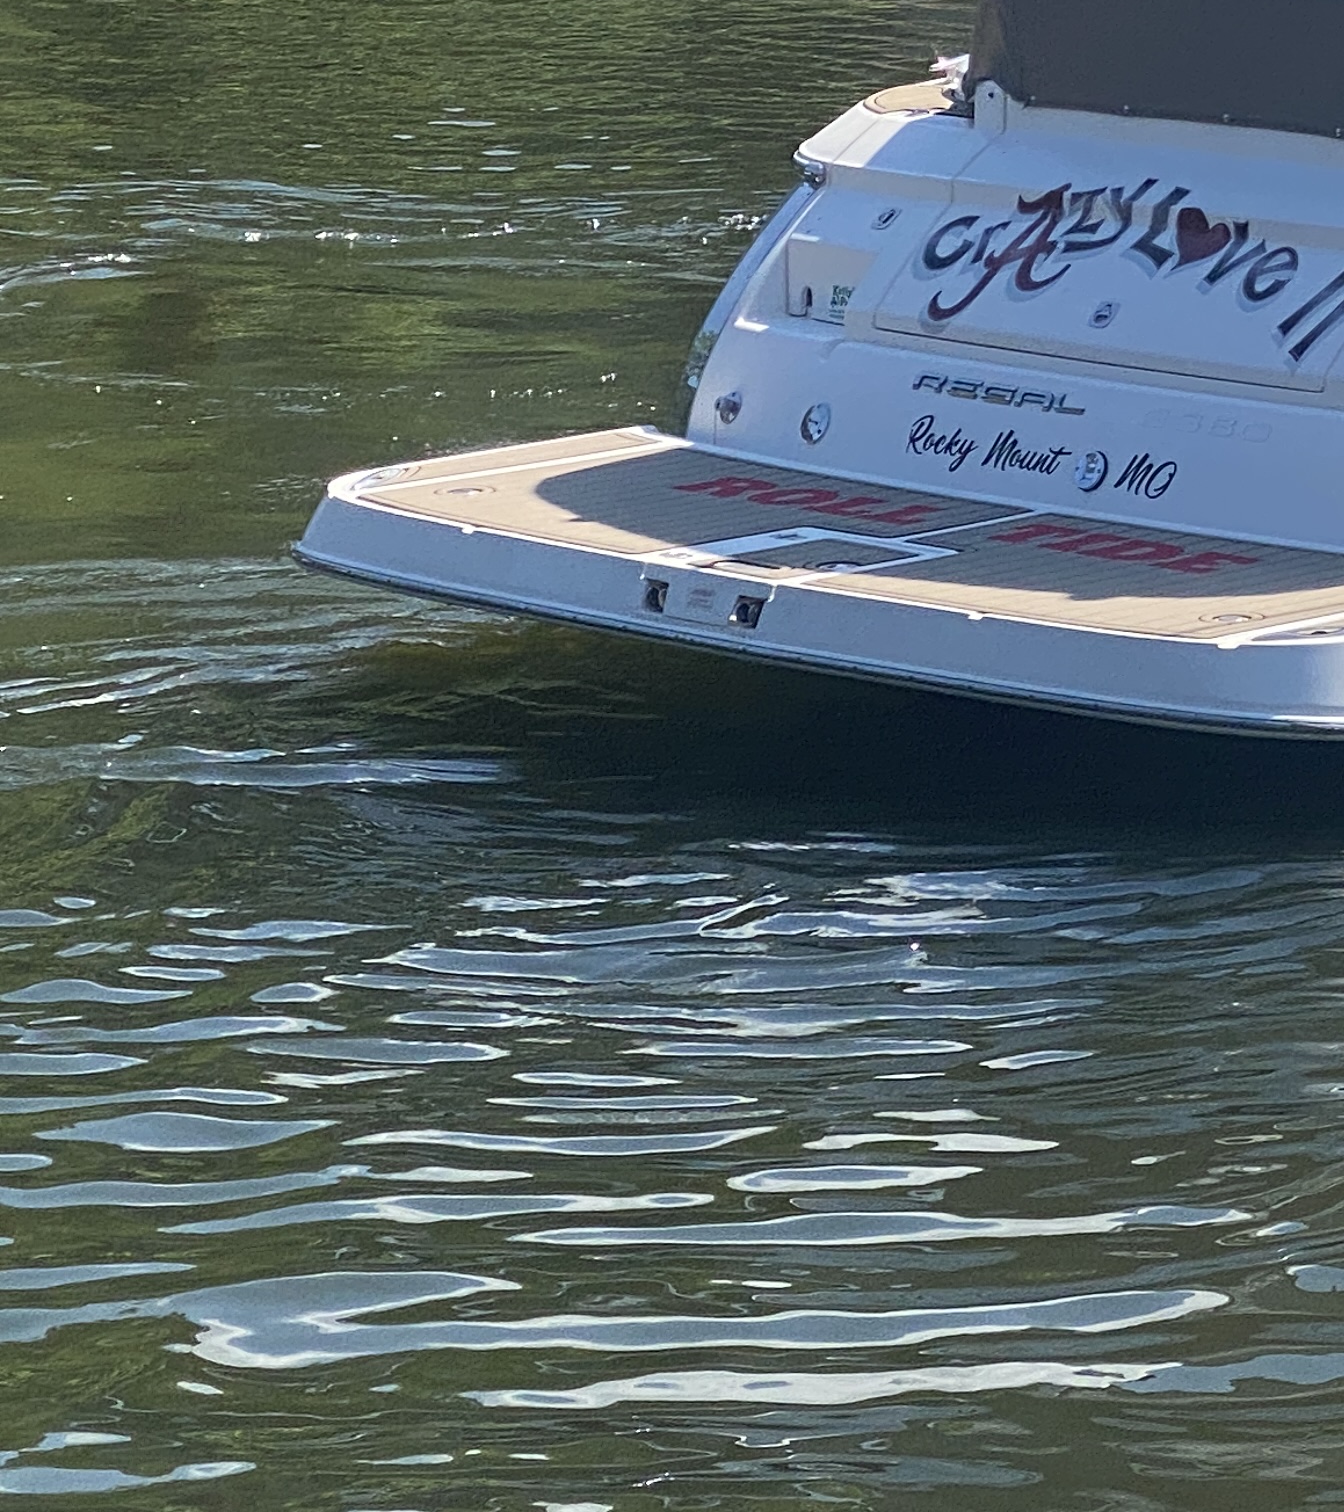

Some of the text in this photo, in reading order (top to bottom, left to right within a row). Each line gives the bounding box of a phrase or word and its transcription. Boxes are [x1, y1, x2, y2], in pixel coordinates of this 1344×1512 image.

[912, 374, 1086, 416] REGAL
[906, 415, 1177, 499] Rocky Mount MO
[673, 476, 1263, 574] ROLL TIDE
